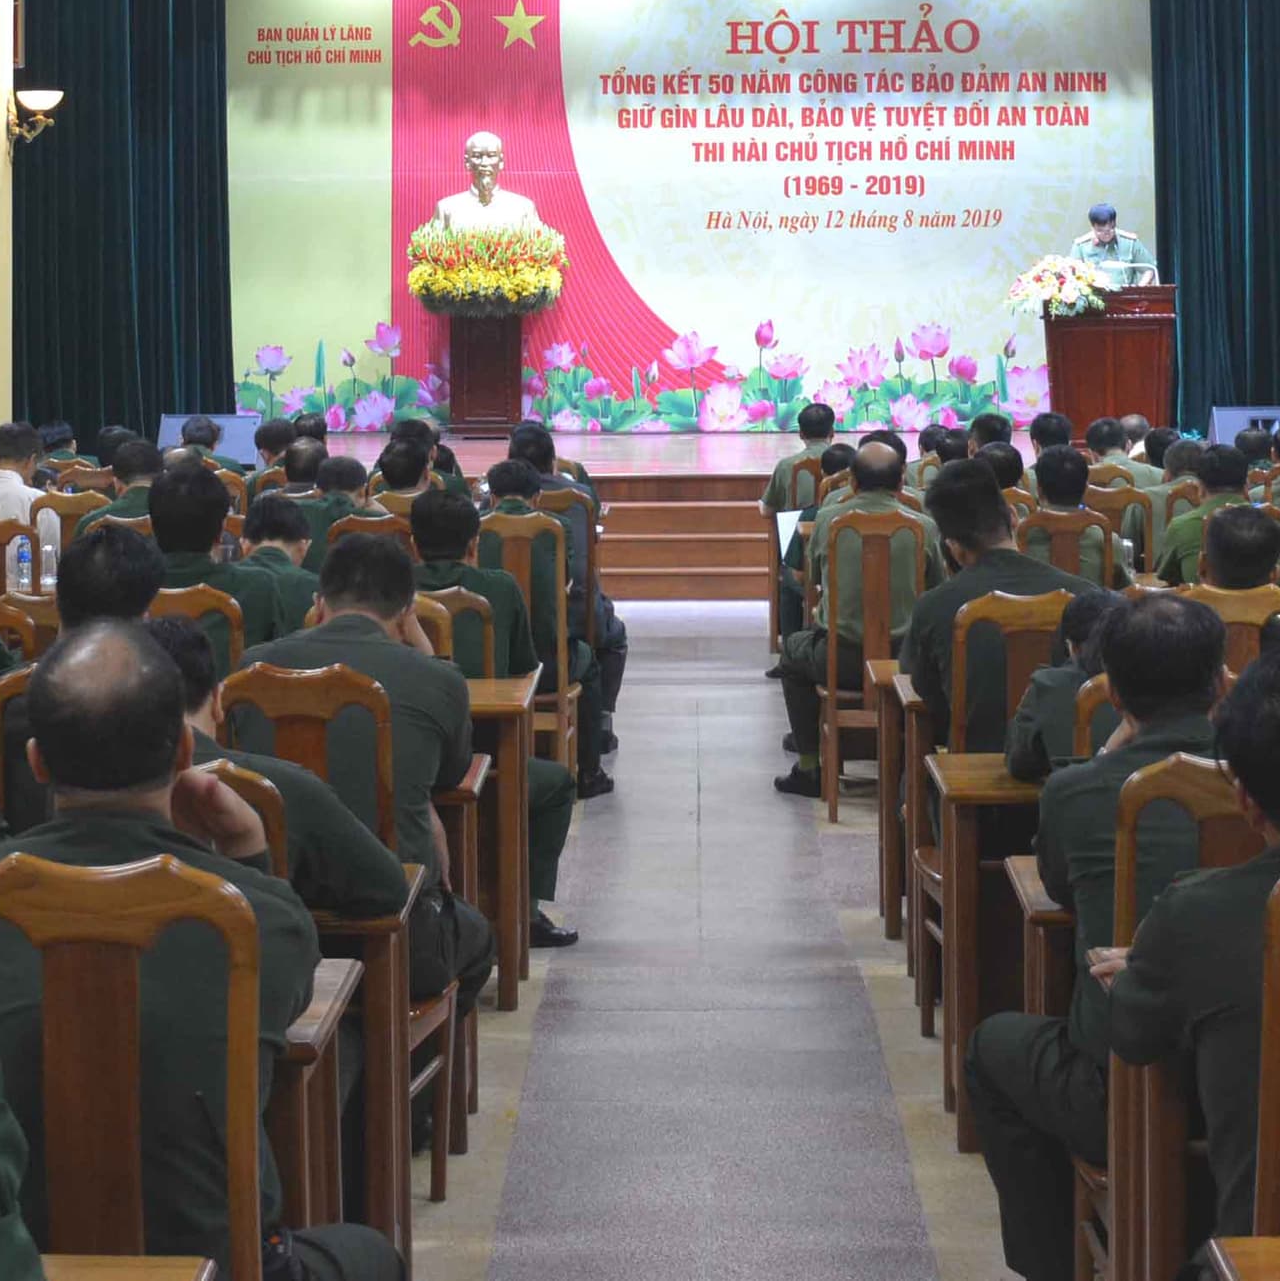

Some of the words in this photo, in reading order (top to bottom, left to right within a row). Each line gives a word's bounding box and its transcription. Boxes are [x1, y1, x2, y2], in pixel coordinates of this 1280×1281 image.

[257, 27, 282, 42] BAN
[286, 21, 319, 42] QUẢN
[323, 24, 336, 41] LÝ
[725, 8, 820, 64] HỘI
[836, 2, 980, 54] THẢO
[248, 44, 271, 64] CHỦ
[276, 50, 301, 67] TỊCH
[306, 45, 321, 64] HỒ
[325, 46, 345, 63] CHÍ
[350, 49, 382, 63] MINH
[599, 66, 656, 95] TỔNG
[662, 66, 702, 95] KẾT
[708, 74, 734, 95] 50
[740, 70, 791, 94] NĂM
[798, 69, 857, 94] CÔNG
[864, 68, 904, 93] TÁC
[911, 63, 954, 93] BẢO
[961, 63, 1009, 93] ĐẢM
[1017, 71, 1047, 92] AN
[1054, 71, 1107, 92] NINH
[617, 103, 656, 129] GIỮ
[660, 103, 697, 128] GÌN
[704, 103, 744, 128] LÂU
[751, 103, 794, 130] DÀI,
[801, 98, 844, 127] BẢO
[850, 102, 876, 131] VỆ
[883, 102, 947, 131] TUYỆT
[954, 98, 989, 126] ĐỐI
[996, 106, 1026, 126] AN
[1033, 102, 1089, 126] TOÀN
[692, 142, 725, 162] THI
[732, 137, 767, 162] HÀI
[775, 132, 817, 162] CHỦ
[825, 140, 872, 165] TỊCH
[880, 134, 908, 161] HỒ
[915, 136, 950, 161] CHÍ
[958, 140, 1015, 161] MINH
[784, 175, 843, 198] (1969
[865, 175, 925, 198] 2019)
[706, 211, 731, 230] Hà
[736, 210, 773, 234] Nội,
[779, 212, 819, 234] ngày
[824, 210, 845, 228] 12
[849, 209, 898, 232] tháng
[903, 209, 914, 228] 8
[919, 210, 956, 228] năm
[961, 209, 1003, 228] 2019
